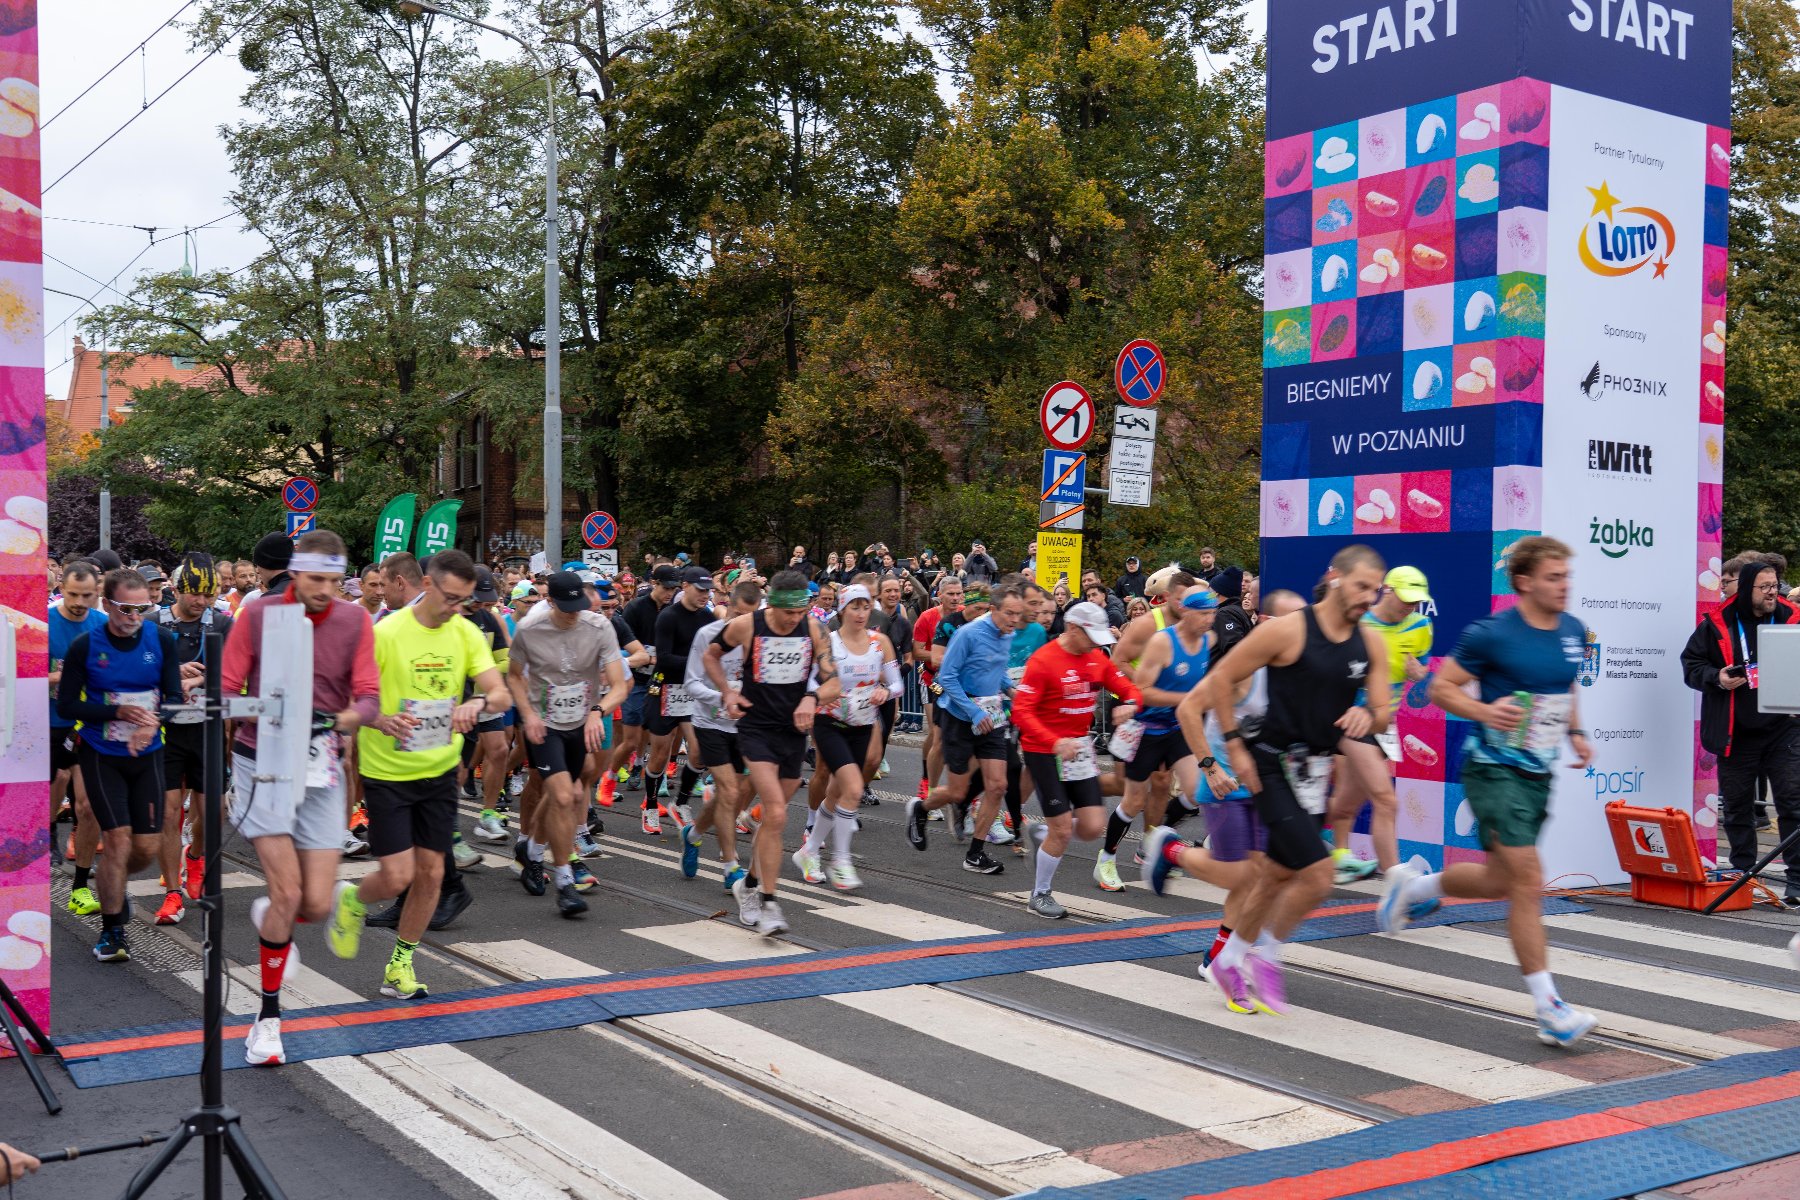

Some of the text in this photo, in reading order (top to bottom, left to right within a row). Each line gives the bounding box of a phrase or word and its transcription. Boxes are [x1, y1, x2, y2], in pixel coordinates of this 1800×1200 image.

[1312, 0, 1458, 74] START
[1568, 0, 1695, 61] START
[1594, 142, 1665, 171] Partner Tytularny
[1598, 221, 1657, 262] LOTTO
[1603, 324, 1647, 343] Sponsorzy
[1287, 372, 1392, 404] BIEGNIEMY
[1332, 424, 1465, 455] W POZNANIU
[1597, 440, 1652, 475] Witt
[1061, 489, 1082, 500] Płatny
[1042, 536, 1077, 548] UWAGA!
[1589, 516, 1654, 548] żabka
[1581, 597, 1662, 613] Patronat Honorowy
[768, 652, 802, 665] 2569
[1606, 646, 1666, 657] Patronat Honorowy
[1606, 658, 1643, 669] Prezydenta
[1606, 670, 1658, 679] Miasta Poznania
[1594, 728, 1645, 742] Organizator
[1595, 765, 1645, 800] posir
